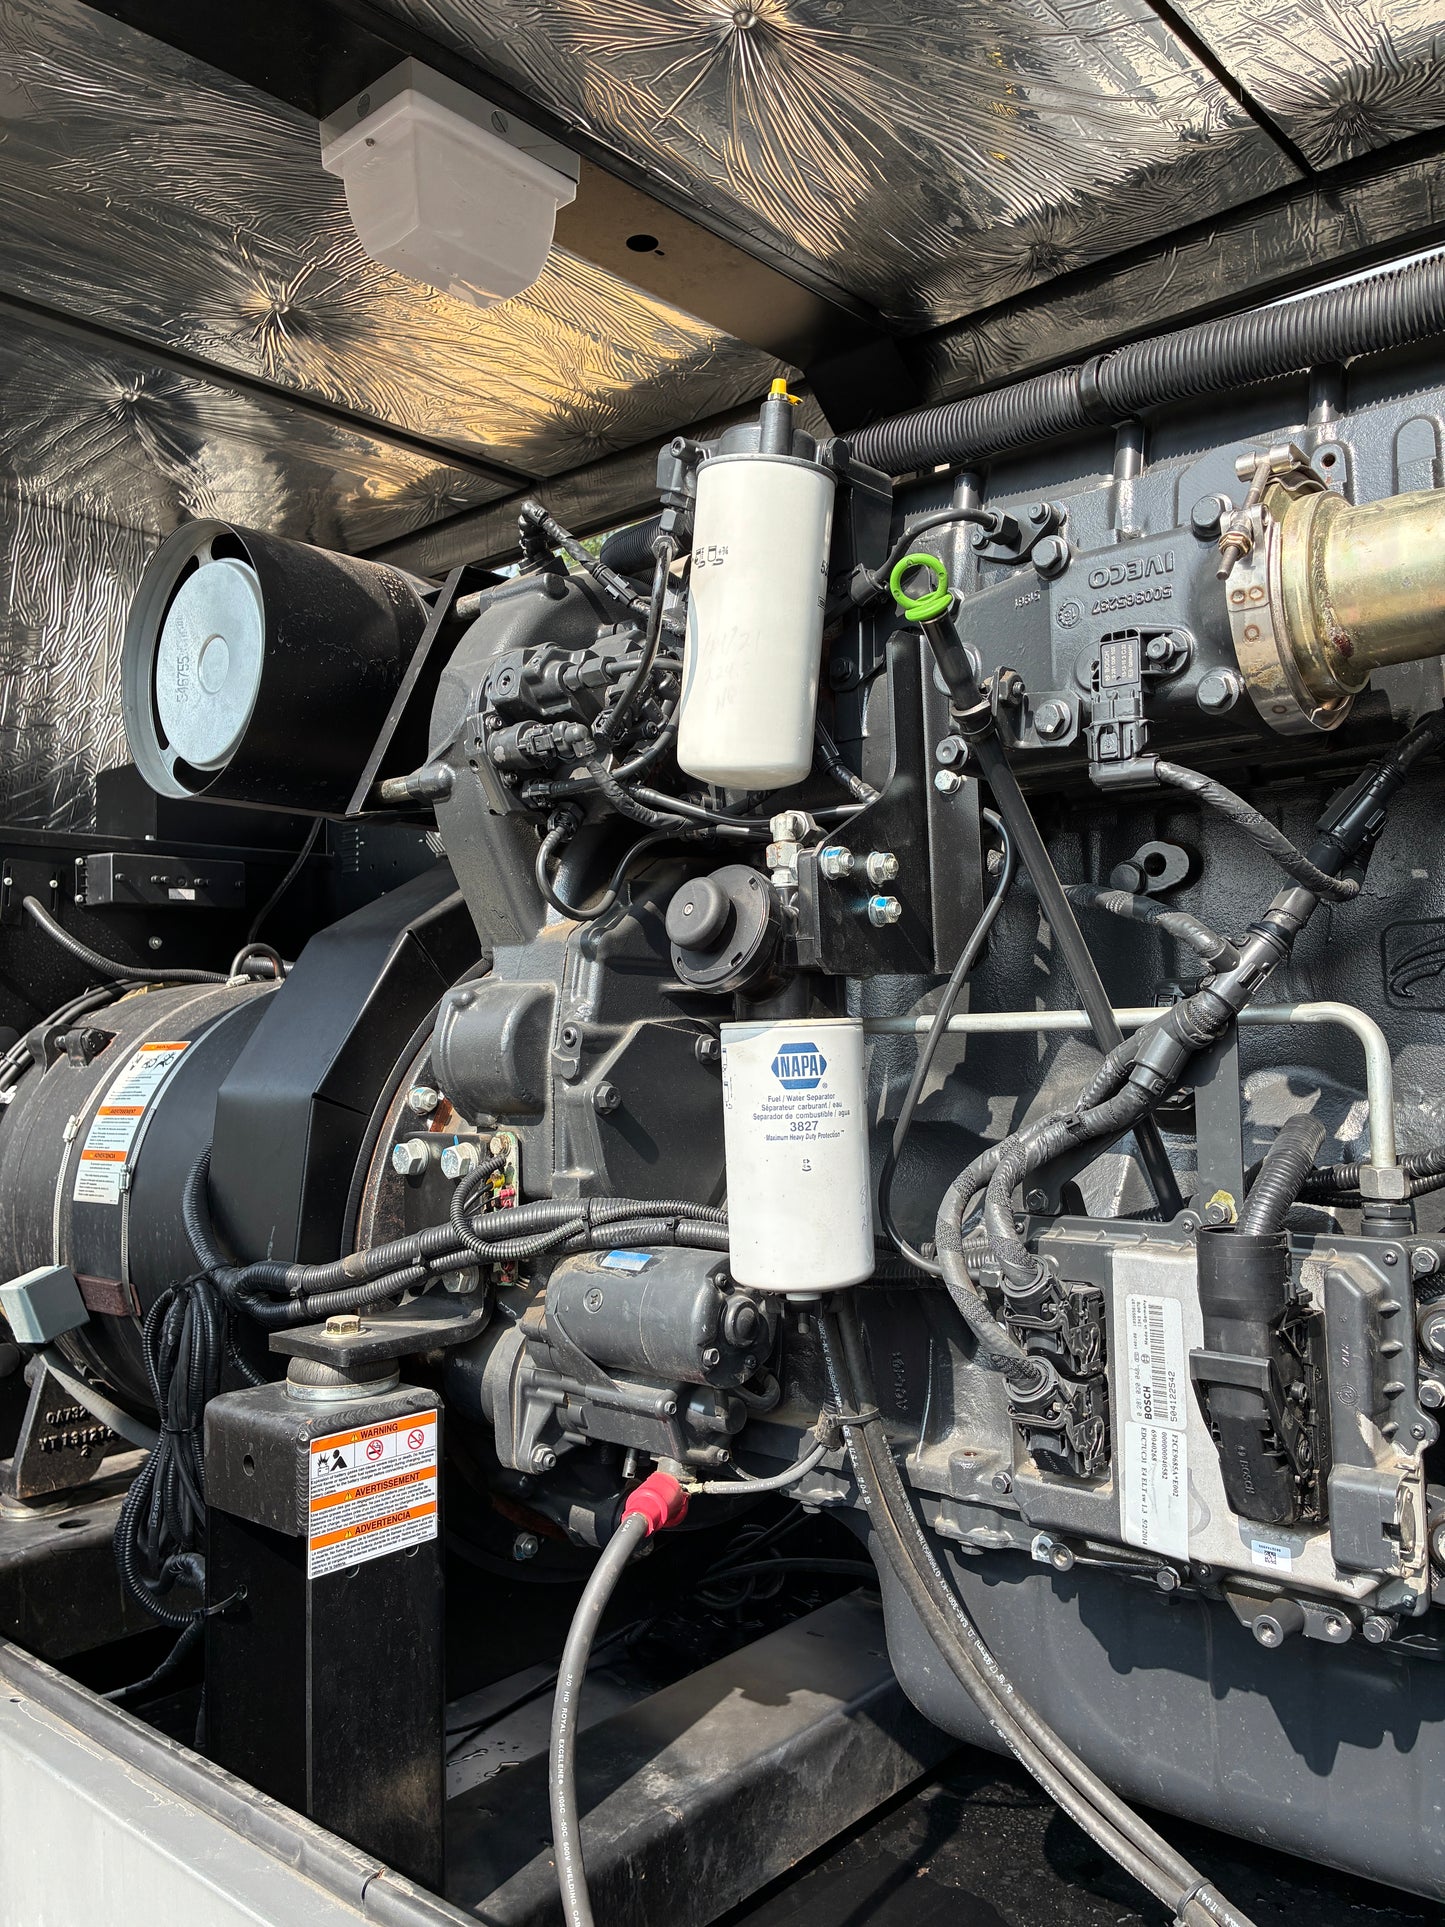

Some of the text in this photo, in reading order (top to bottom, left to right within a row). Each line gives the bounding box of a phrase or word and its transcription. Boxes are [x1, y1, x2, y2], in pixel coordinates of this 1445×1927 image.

[1089, 551, 1175, 589] IVECO
[780, 1055, 820, 1078] NAPA
[761, 1104, 795, 1113] Séparateur
[797, 1102, 827, 1110] carburant
[786, 1094, 805, 1102] Water
[807, 1093, 835, 1102] Separator
[753, 1113, 783, 1121] Separador
[796, 1111, 833, 1119] combustible
[838, 1109, 850, 1117] agua
[790, 1121, 819, 1132] 3827
[790, 1133, 804, 1142] Heavy
[1143, 1386, 1152, 1420] BOSCH
[1168, 1370, 1177, 1422] 504122542
[360, 1423, 398, 1439] WARNING
[1141, 1467, 1147, 1476] E4
[1238, 1458, 1255, 1495] BOSCH
[355, 1472, 421, 1497] AVERTISSEMENT
[354, 1511, 411, 1535] ADVERTENCIA
[565, 1673, 573, 1687] 3/0
[562, 1690, 571, 1703] HD
[559, 1707, 568, 1733] ROYAL
[563, 1841, 572, 1862] 600V
[566, 1866, 576, 1904] WELDING
